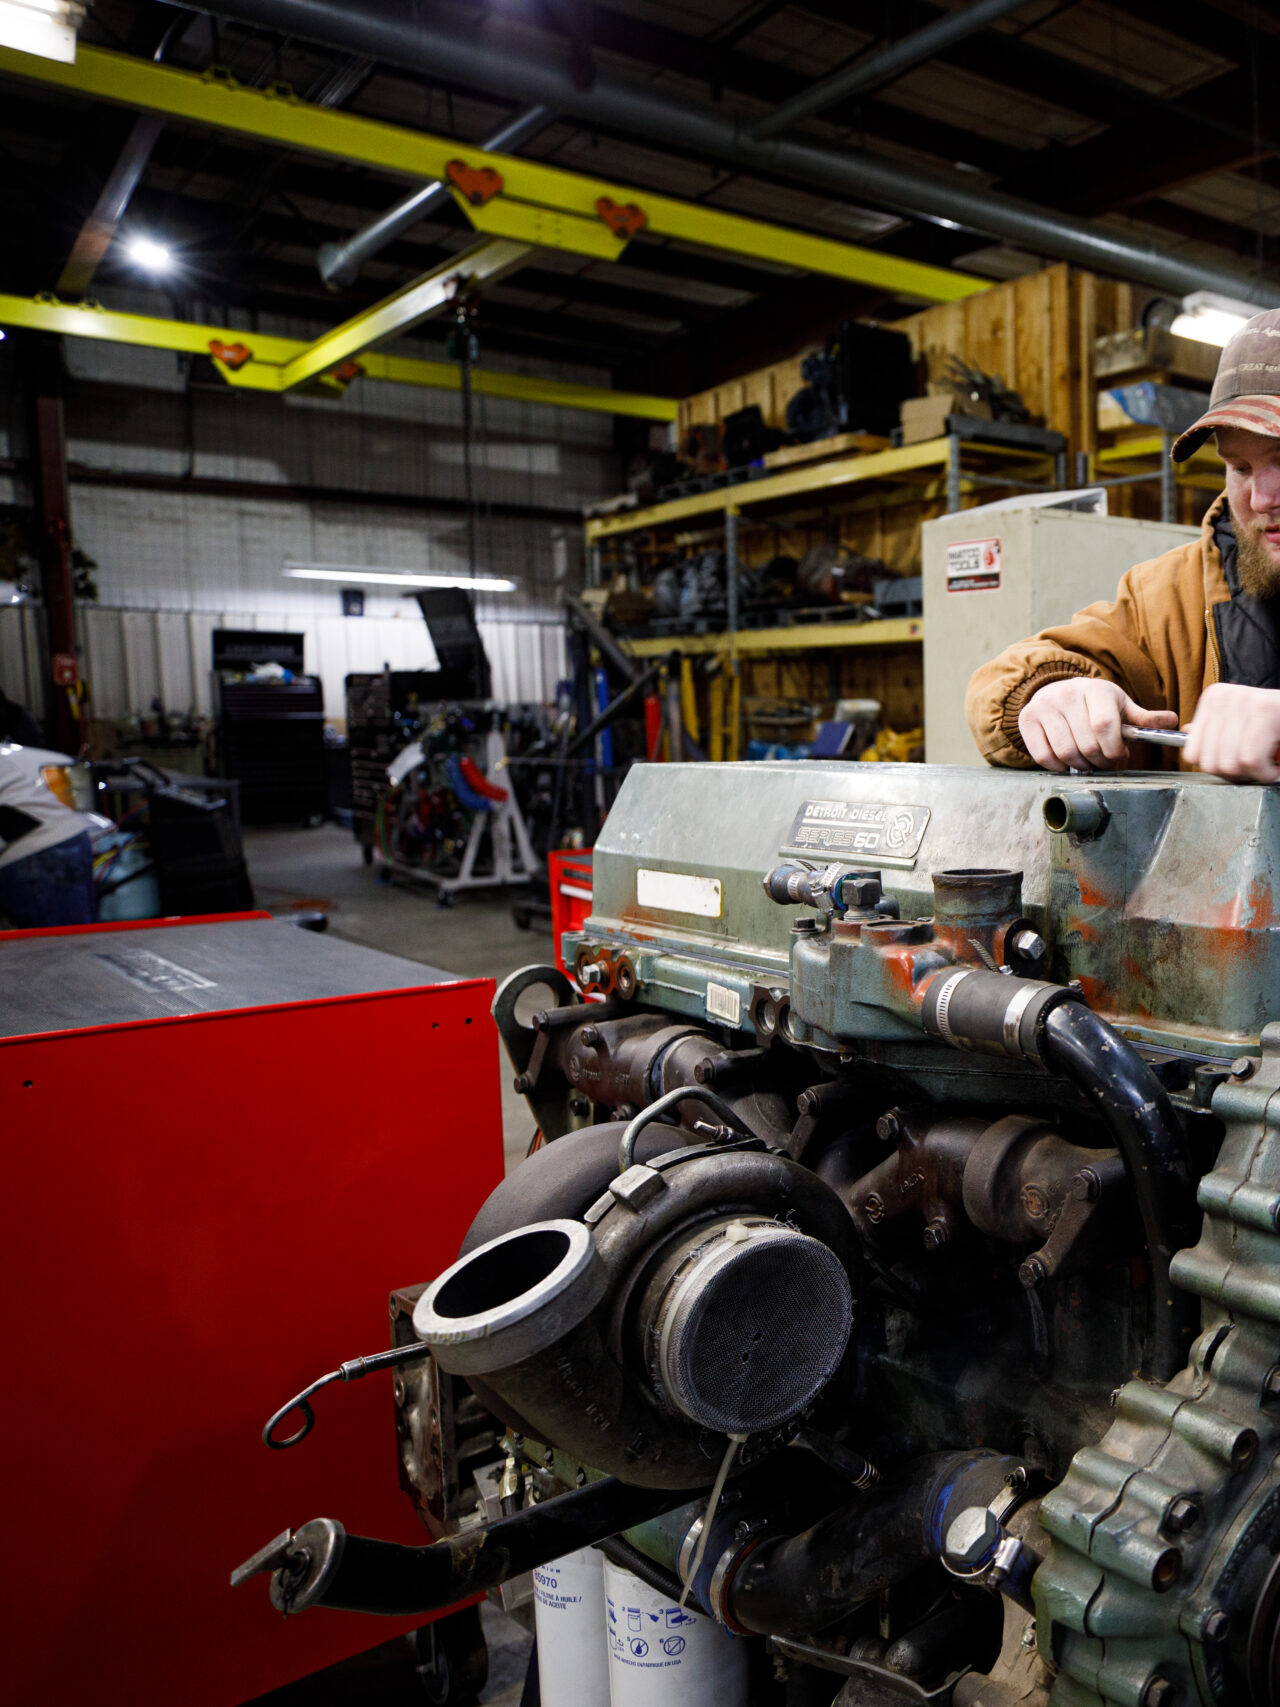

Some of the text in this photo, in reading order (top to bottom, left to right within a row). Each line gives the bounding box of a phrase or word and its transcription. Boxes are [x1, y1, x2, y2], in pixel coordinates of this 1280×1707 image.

[804, 805, 888, 821] DETROIT DIESEL
[795, 826, 881, 849] SERIES 60
